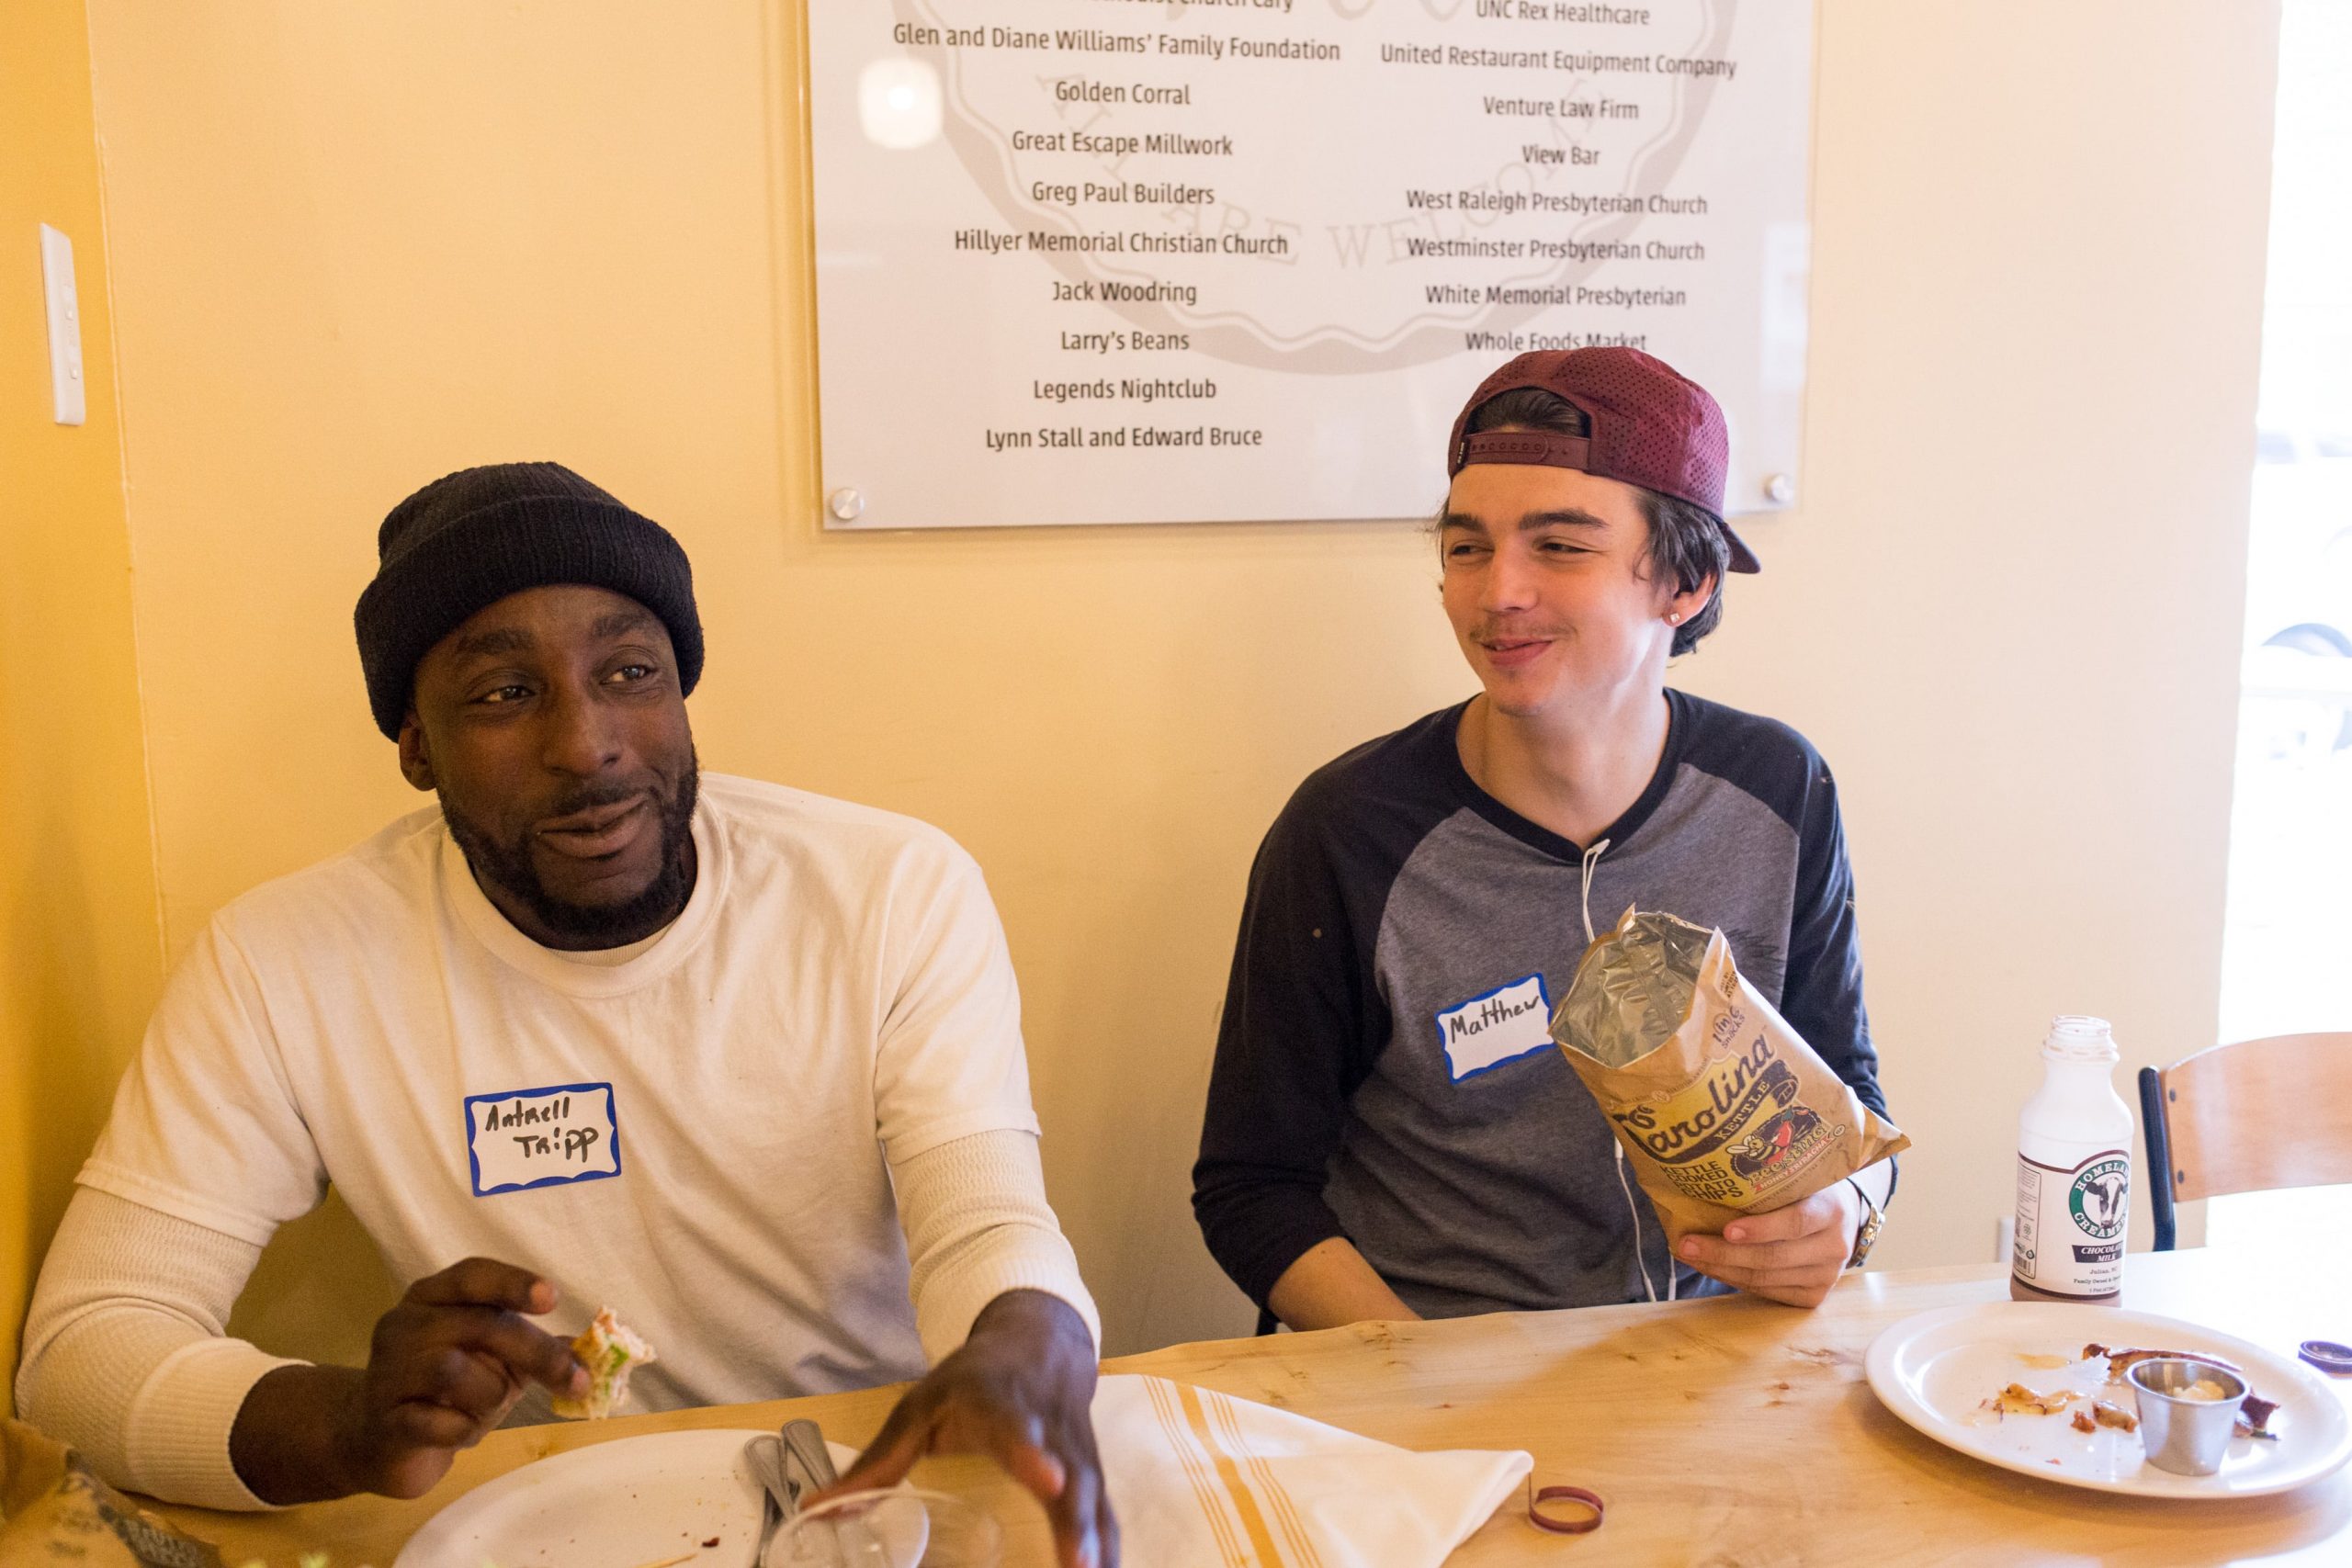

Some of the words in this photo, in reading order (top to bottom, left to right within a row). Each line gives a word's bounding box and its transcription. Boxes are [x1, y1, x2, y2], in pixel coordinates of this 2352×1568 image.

[1476, 0, 1513, 19] UNC
[1518, 1, 1549, 21] Rex
[1554, 2, 1650, 26] Healthcare
[893, 21, 941, 46] Glen
[945, 25, 986, 48] and
[991, 26, 1050, 51] Diane
[1158, 33, 1225, 60] Family
[1229, 36, 1340, 61] Foundation
[1381, 43, 1443, 65] United
[1448, 45, 1548, 69] Restaurant
[1553, 50, 1651, 74] Equipment
[1655, 54, 1737, 81] Company
[1055, 80, 1126, 104] Golden
[1131, 83, 1192, 106] Corral
[1483, 96, 1555, 118] Venture
[1559, 98, 1596, 119] Law
[1599, 98, 1640, 119] Firm
[1012, 130, 1067, 152] Great
[1071, 130, 1140, 158] Escape
[1145, 132, 1233, 156] Millwork
[1521, 143, 1566, 165] View
[1570, 144, 1600, 166] Bar
[1032, 180, 1078, 207] Greg
[1083, 181, 1129, 204] Paul
[1133, 182, 1216, 206] Builders
[1406, 189, 1453, 210] West
[1458, 188, 1528, 215] Raleigh
[1531, 191, 1645, 217] Presbyterian
[1647, 194, 1708, 215] Church
[955, 228, 1023, 255] Hillyer
[1027, 231, 1125, 253] Memorial
[1129, 231, 1218, 254] Christian
[1220, 231, 1289, 255] Church
[1406, 237, 1525, 258] Westminster
[1529, 237, 1642, 264] Presbyterian
[1645, 241, 1705, 261] Church
[1052, 279, 1095, 302] Jack
[1099, 279, 1197, 307] Woodring
[1425, 284, 1481, 305] White
[1485, 284, 1571, 306] Memorial
[1576, 286, 1687, 310] Presbyterian
[1060, 330, 1126, 354] Larry's
[1131, 330, 1191, 351] Beans
[1464, 331, 1524, 352] Whole
[1529, 332, 1581, 354] Foods
[1586, 332, 1647, 351] Market
[1033, 378, 1116, 404] Legends
[1120, 378, 1217, 404] Nightclub
[986, 428, 1033, 453] Lynn
[1037, 426, 1085, 448] Stall
[1088, 425, 1126, 448] and
[1131, 425, 1204, 447] Edward
[1209, 426, 1263, 447] Bruce
[1450, 995, 1540, 1044] Matthew
[1612, 1033, 1775, 1156] Carolina
[1714, 1080, 1770, 1141] KETTLE
[1660, 1160, 1722, 1176] KETTLE
[1668, 1169, 1728, 1183] COOKED
[2075, 1162, 2129, 1191] HOMELA
[1674, 1179, 1736, 1191] POTATO
[1681, 1186, 1744, 1201] CHIPS
[2075, 1213, 2125, 1237] CREAME
[2081, 1243, 2122, 1255] CHOCOL
[2097, 1253, 2117, 1262] MILK
